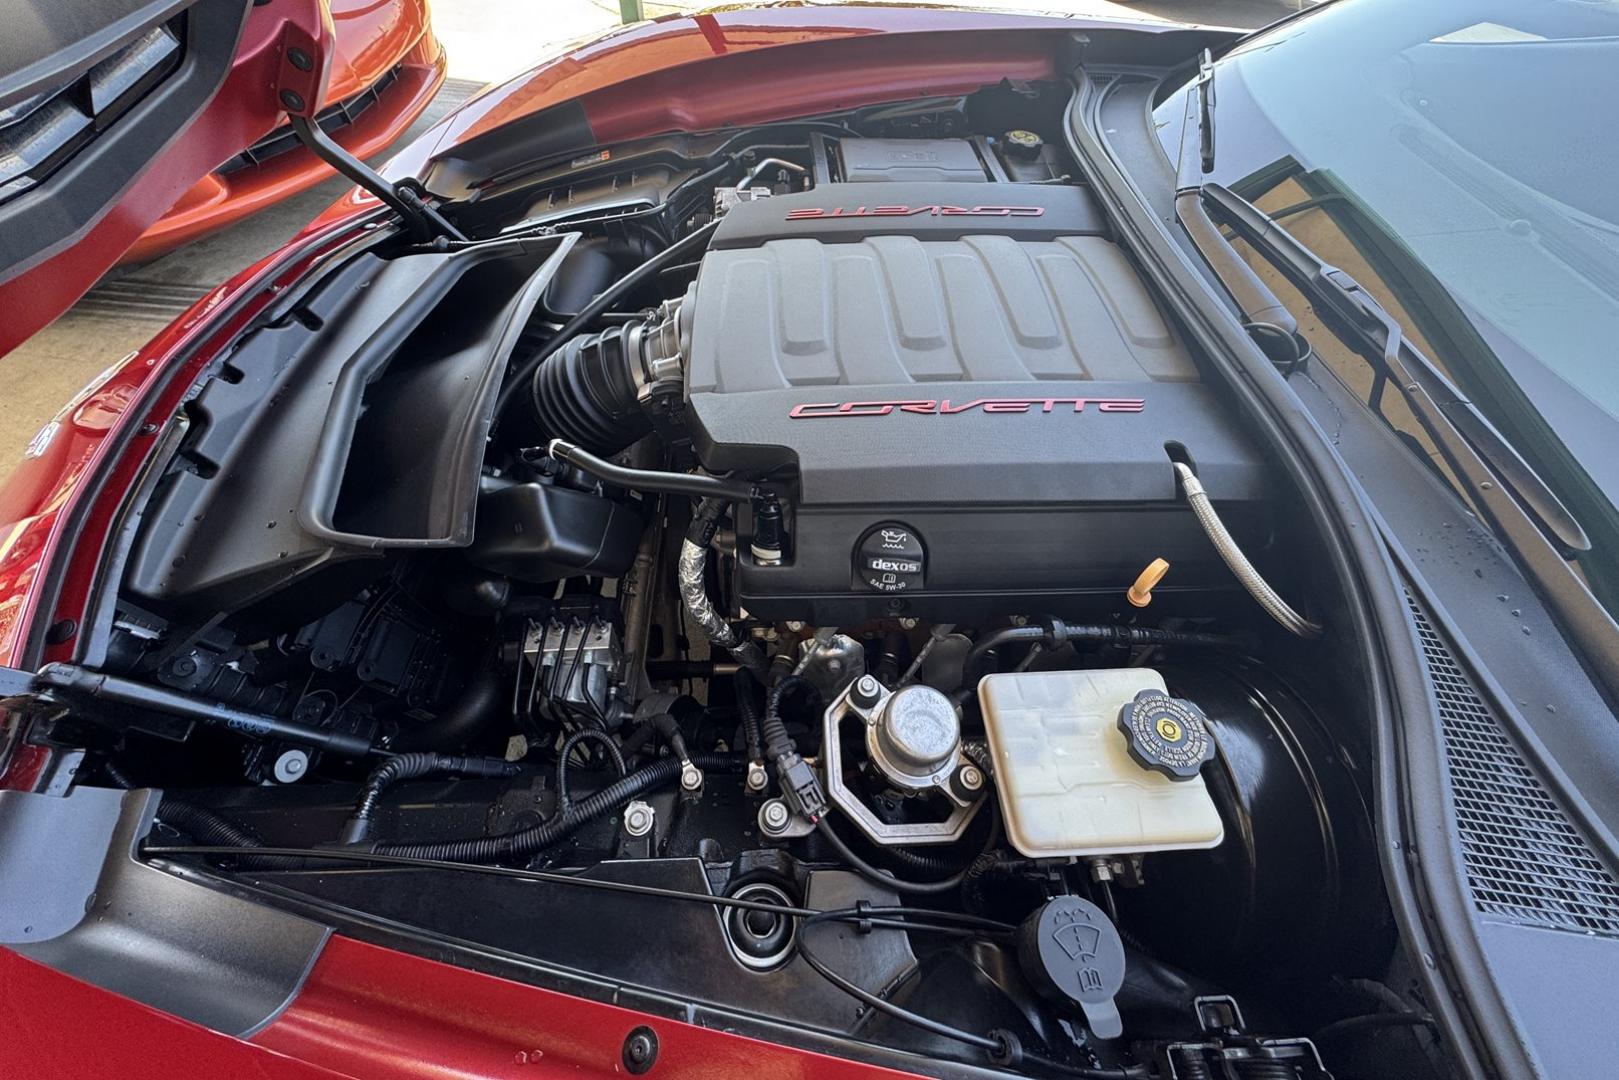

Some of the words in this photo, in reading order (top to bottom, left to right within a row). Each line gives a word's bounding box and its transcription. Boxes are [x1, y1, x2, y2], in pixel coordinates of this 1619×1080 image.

[786, 206, 1045, 220] CORVETTE
[789, 398, 1145, 419] CORVETTE
[872, 559, 917, 571] dexos
[870, 579, 884, 590] SAE
